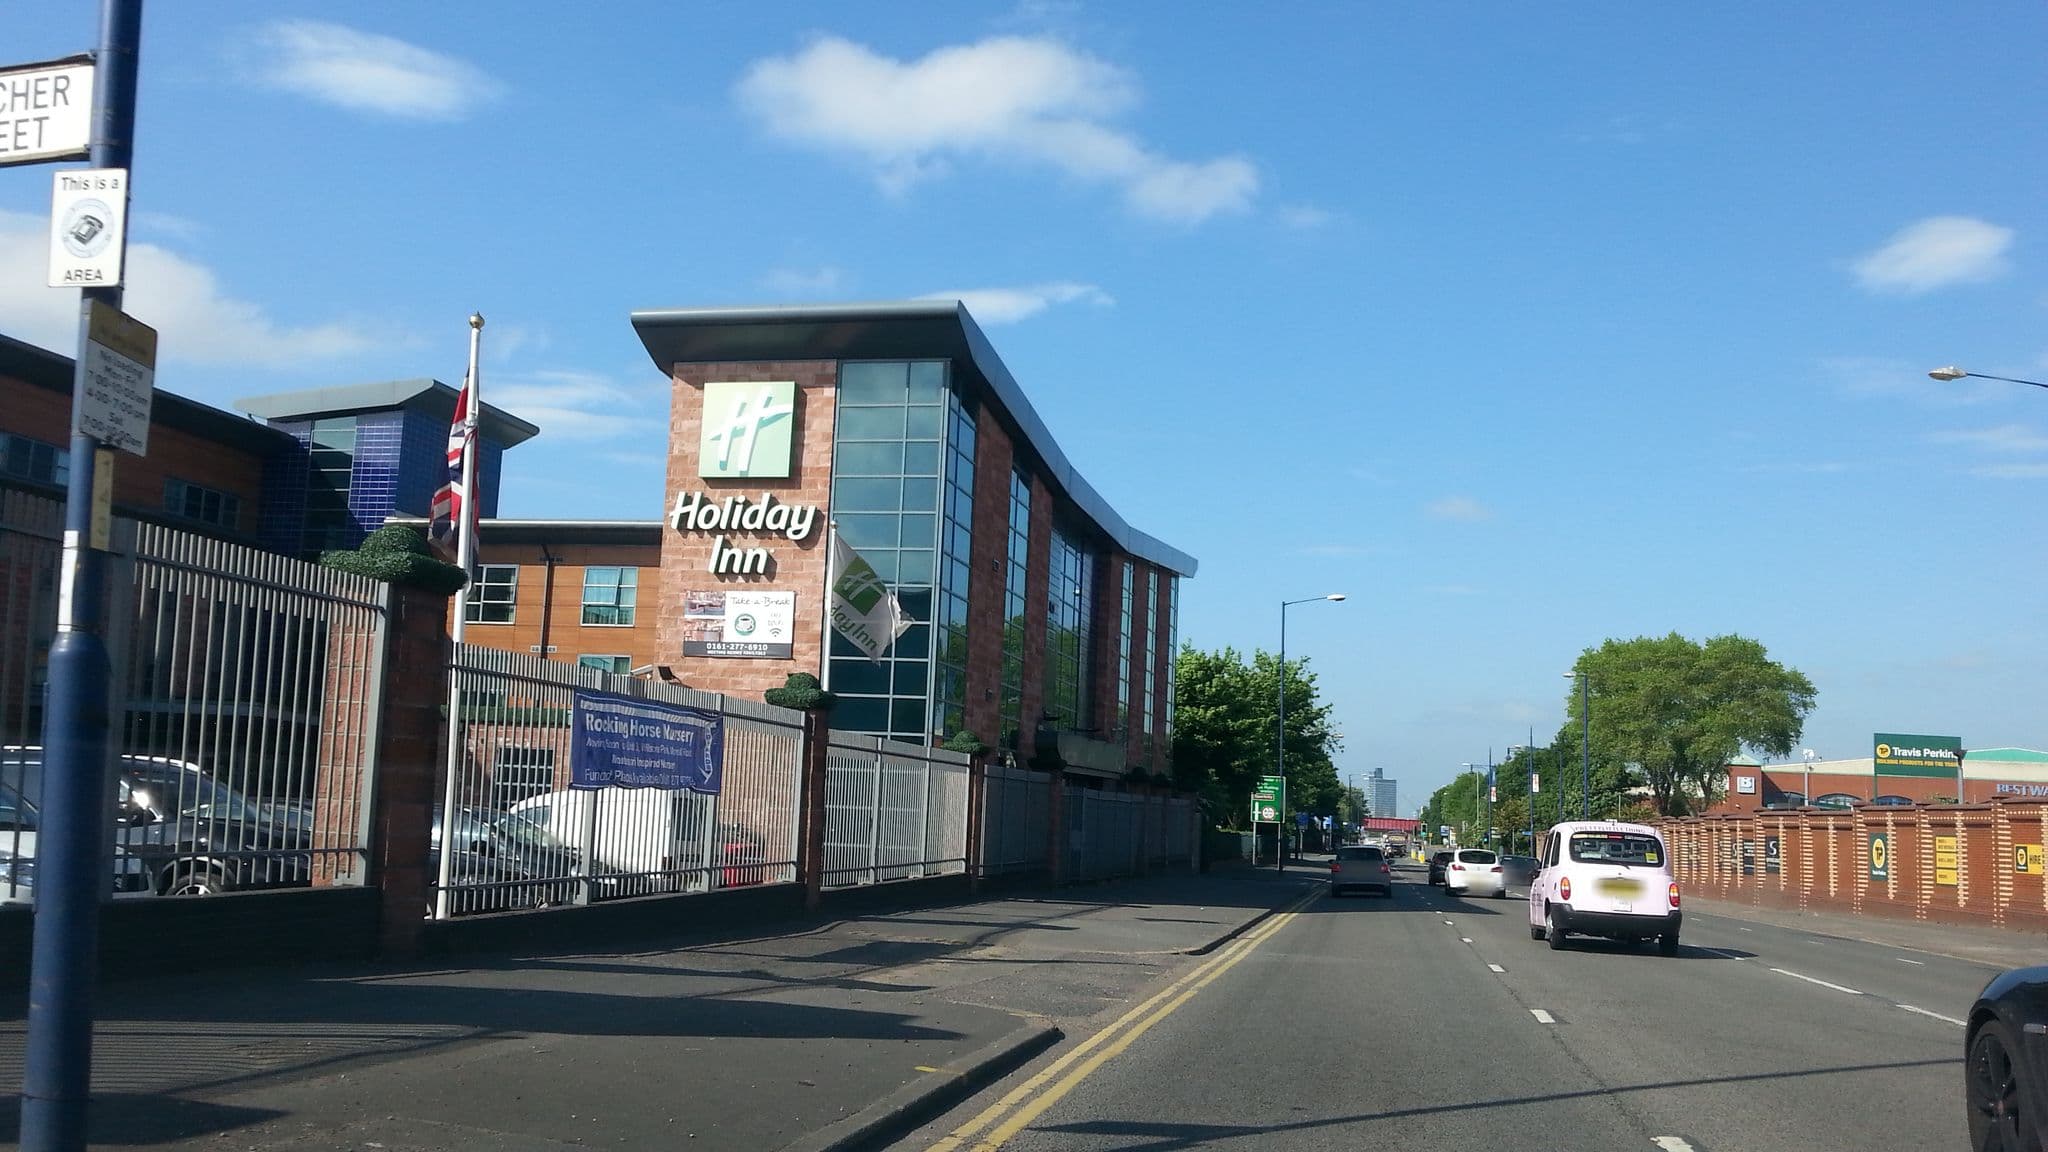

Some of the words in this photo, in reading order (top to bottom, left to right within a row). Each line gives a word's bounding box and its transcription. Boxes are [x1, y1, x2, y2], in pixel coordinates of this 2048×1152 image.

[62, 177, 90, 190] This
[95, 177, 106, 190] is
[111, 179, 119, 189] a
[64, 269, 103, 281] AREA
[669, 491, 816, 540] Holiday
[708, 535, 768, 574] Inn
[706, 642, 768, 651] 0161-277-6910
[852, 624, 877, 651] Inn
[585, 713, 629, 739] Rocking
[629, 719, 662, 739] Horse
[663, 723, 694, 745] Nursery
[1892, 747, 1922, 757] Travis
